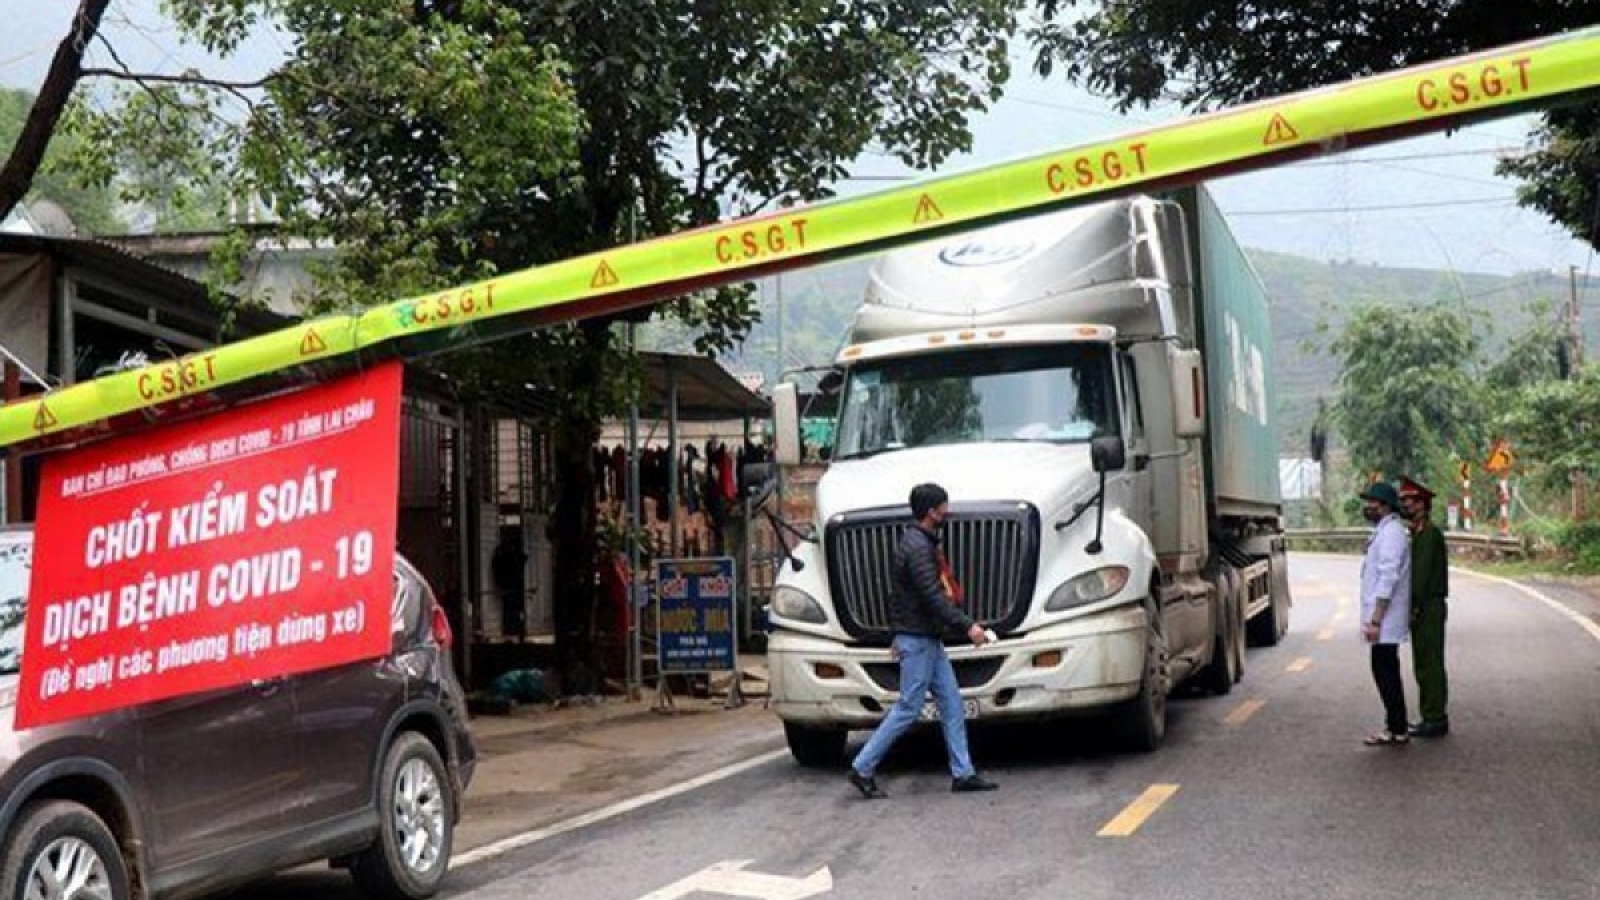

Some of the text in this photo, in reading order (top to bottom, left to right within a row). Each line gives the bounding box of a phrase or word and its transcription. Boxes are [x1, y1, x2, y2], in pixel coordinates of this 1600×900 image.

[1417, 59, 1531, 111] C.S.G.T
[1047, 143, 1147, 193] C.S.G.T
[715, 219, 808, 263] C.S.G.T
[138, 355, 216, 400] C.S.G.T
[86, 465, 337, 568] CHỐT KIỂM SOÁT
[43, 591, 112, 652] DỊCH
[117, 571, 200, 632] BỆNH
[207, 547, 302, 608] COVID
[335, 531, 373, 580] 19
[40, 658, 73, 700] (Đề
[75, 654, 116, 690] nghị
[118, 648, 153, 680] các
[233, 621, 272, 658] tiện
[332, 600, 365, 635] xe)
